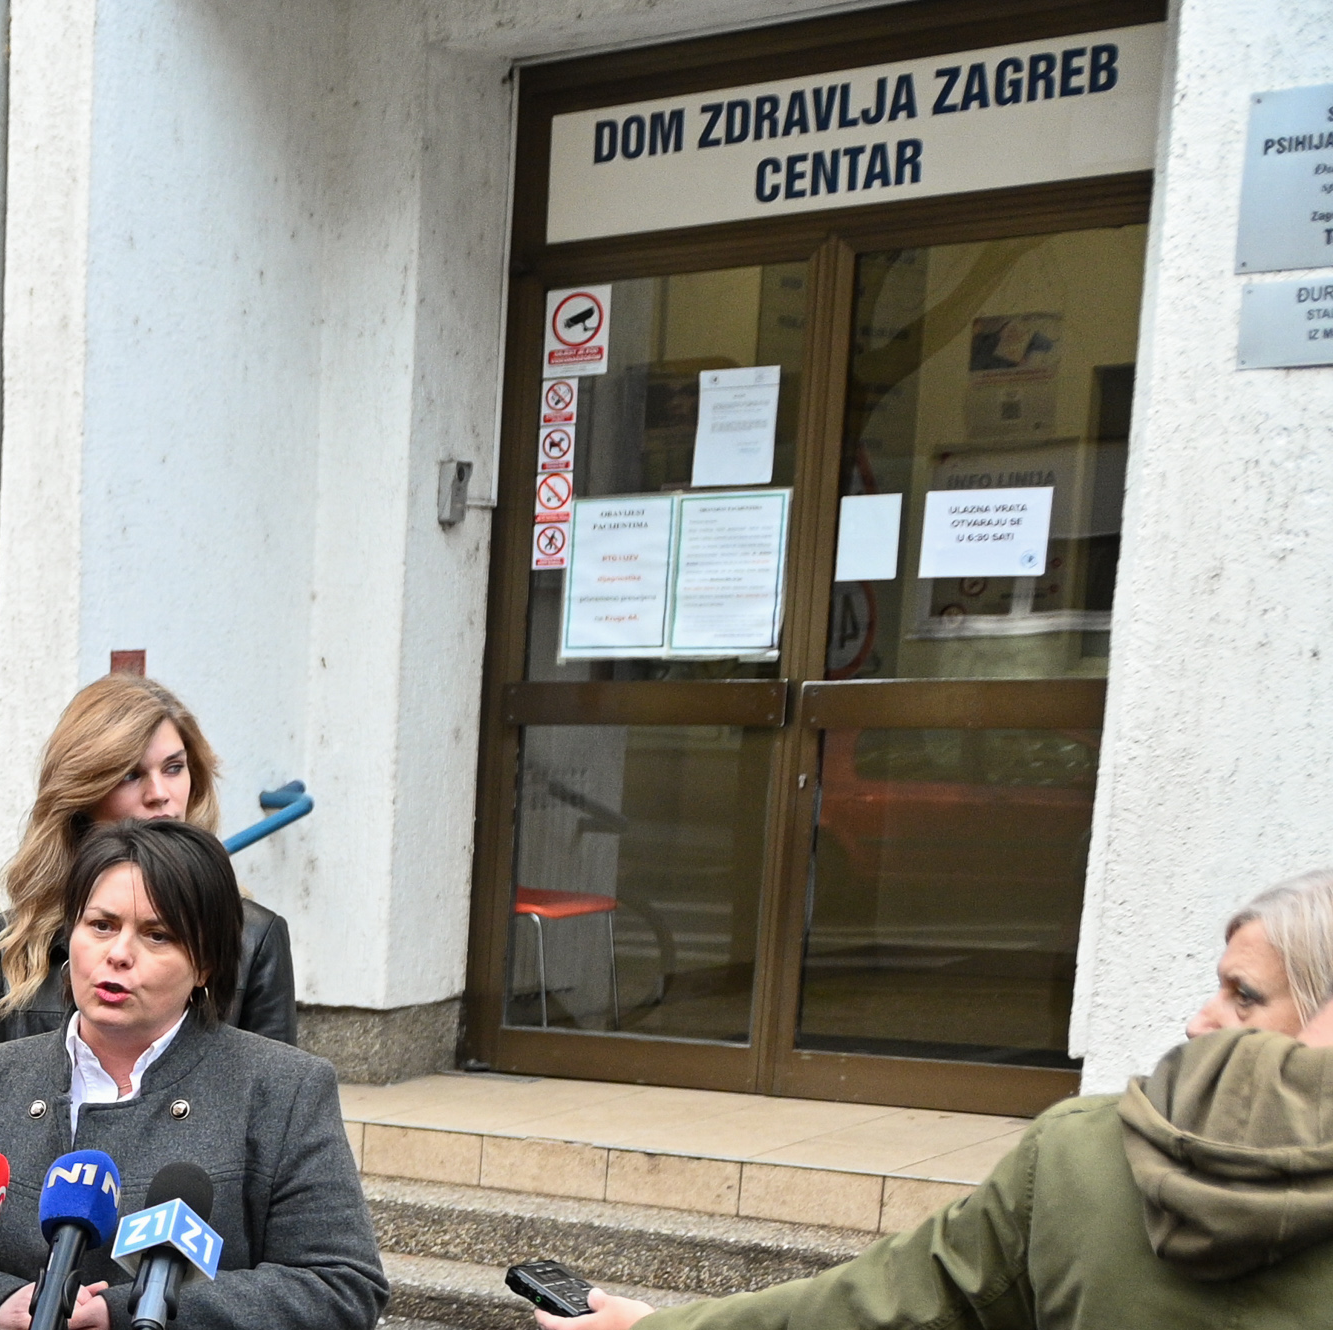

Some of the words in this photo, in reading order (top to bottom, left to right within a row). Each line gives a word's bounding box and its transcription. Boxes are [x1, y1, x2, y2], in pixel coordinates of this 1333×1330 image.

[593, 107, 685, 164] DOM
[698, 73, 918, 149] ZDRAVLJA
[933, 42, 1120, 114] ZAGREB
[756, 138, 924, 202] CENTAR
[1307, 308, 1333, 321] STA
[948, 505, 991, 515] ULAZNA
[993, 503, 1028, 513] VRATA
[951, 518, 1007, 528] OTVARAJU
[1010, 517, 1023, 526] SE
[957, 533, 965, 542] U
[992, 532, 1015, 541] SATI
[47, 1162, 98, 1188] N1
[124, 1209, 167, 1246] Z1
[180, 1214, 214, 1265] Z1
